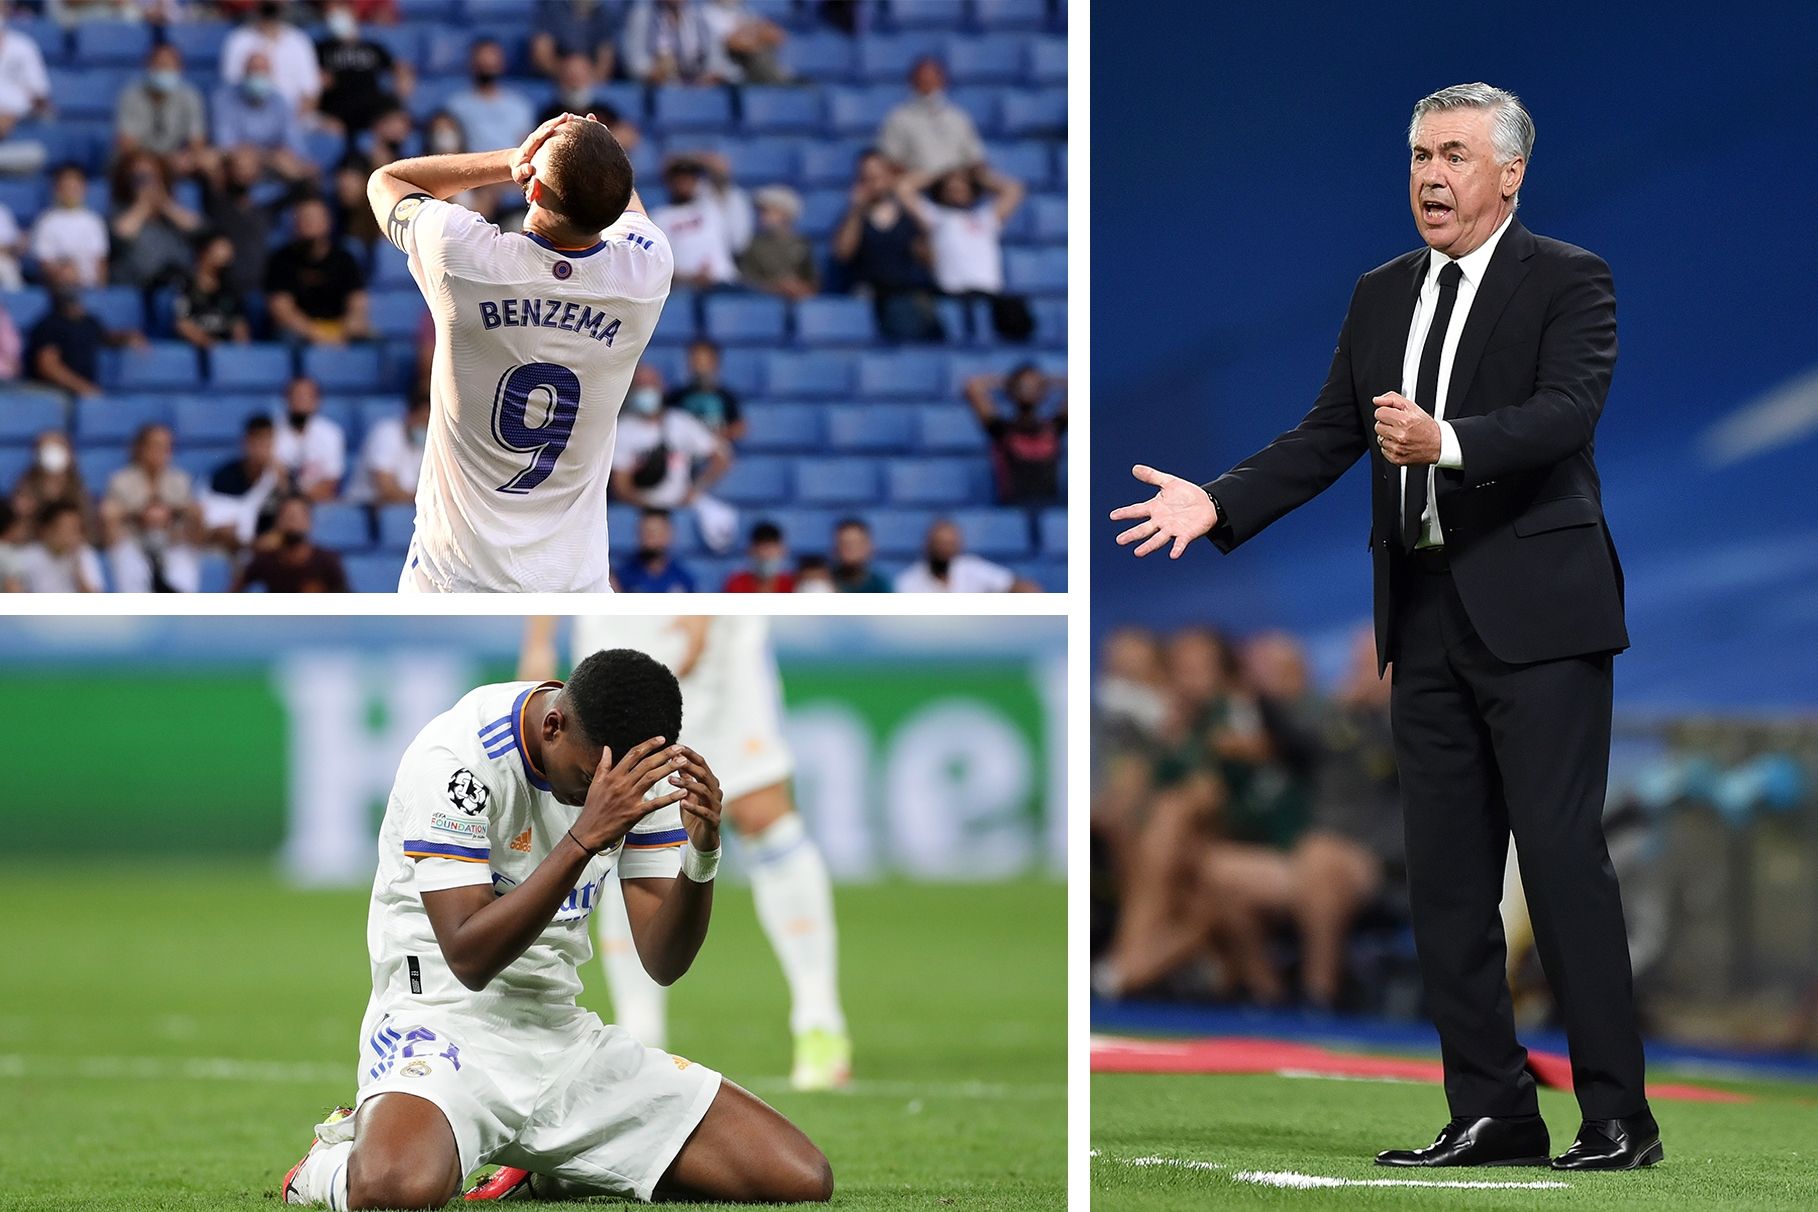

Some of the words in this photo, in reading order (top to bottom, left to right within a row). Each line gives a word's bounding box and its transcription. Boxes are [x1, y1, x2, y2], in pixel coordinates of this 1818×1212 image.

[478, 298, 622, 348] BENZEMA
[491, 362, 581, 494] 9
[431, 818, 487, 834] FOUNDATION
